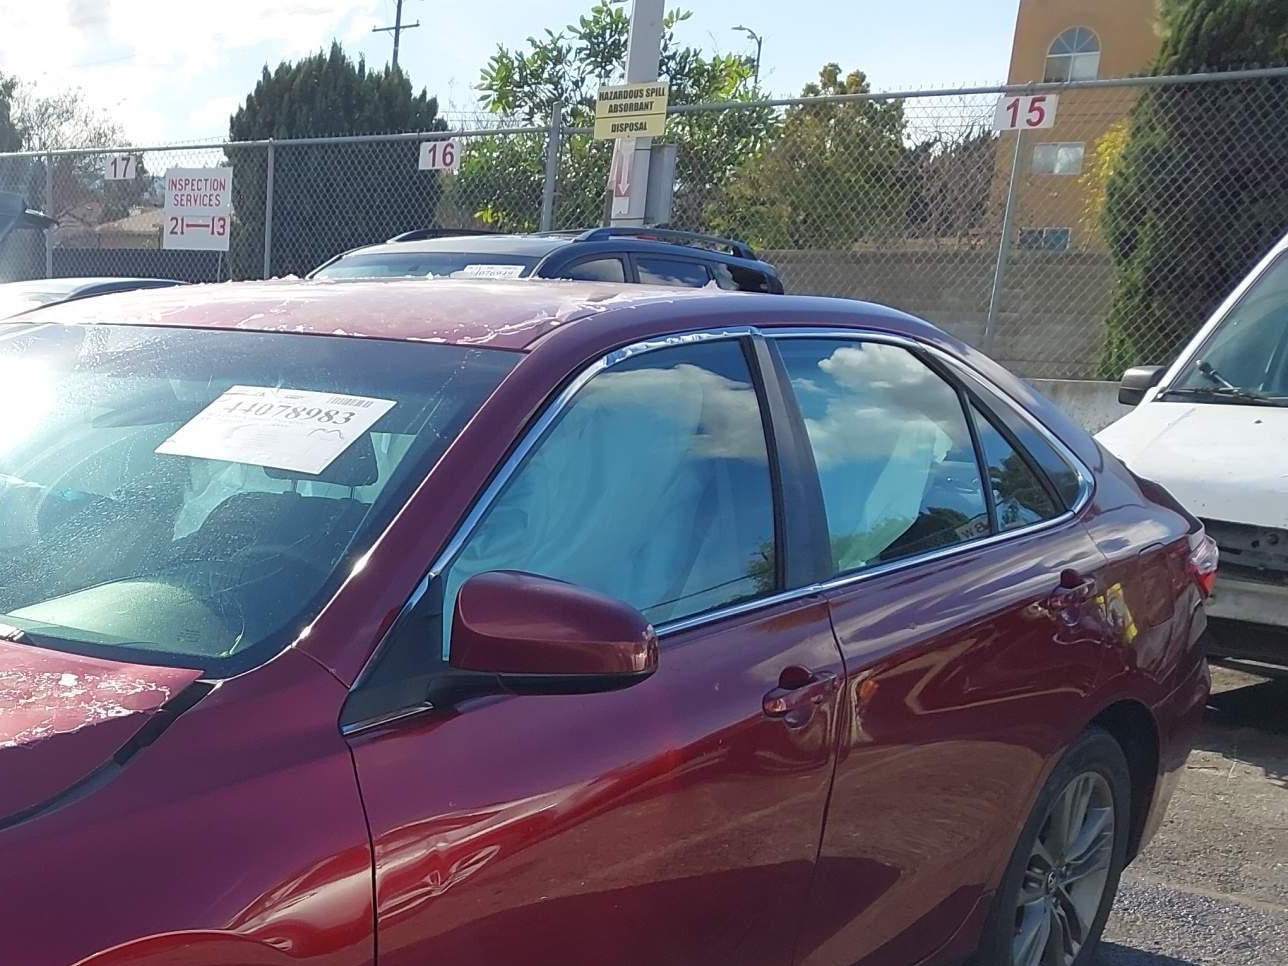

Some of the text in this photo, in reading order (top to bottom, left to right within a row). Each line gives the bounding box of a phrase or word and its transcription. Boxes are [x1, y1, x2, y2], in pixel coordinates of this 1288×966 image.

[598, 87, 665, 101] HAZARDOUS SPILL
[607, 101, 654, 113] ABSORBANT
[1006, 96, 1047, 128] 15
[610, 121, 648, 133] DISPOSAL
[428, 143, 455, 168] 16
[110, 157, 131, 178] 17
[167, 177, 226, 192] INSPECTION
[173, 193, 221, 207] SERVICES
